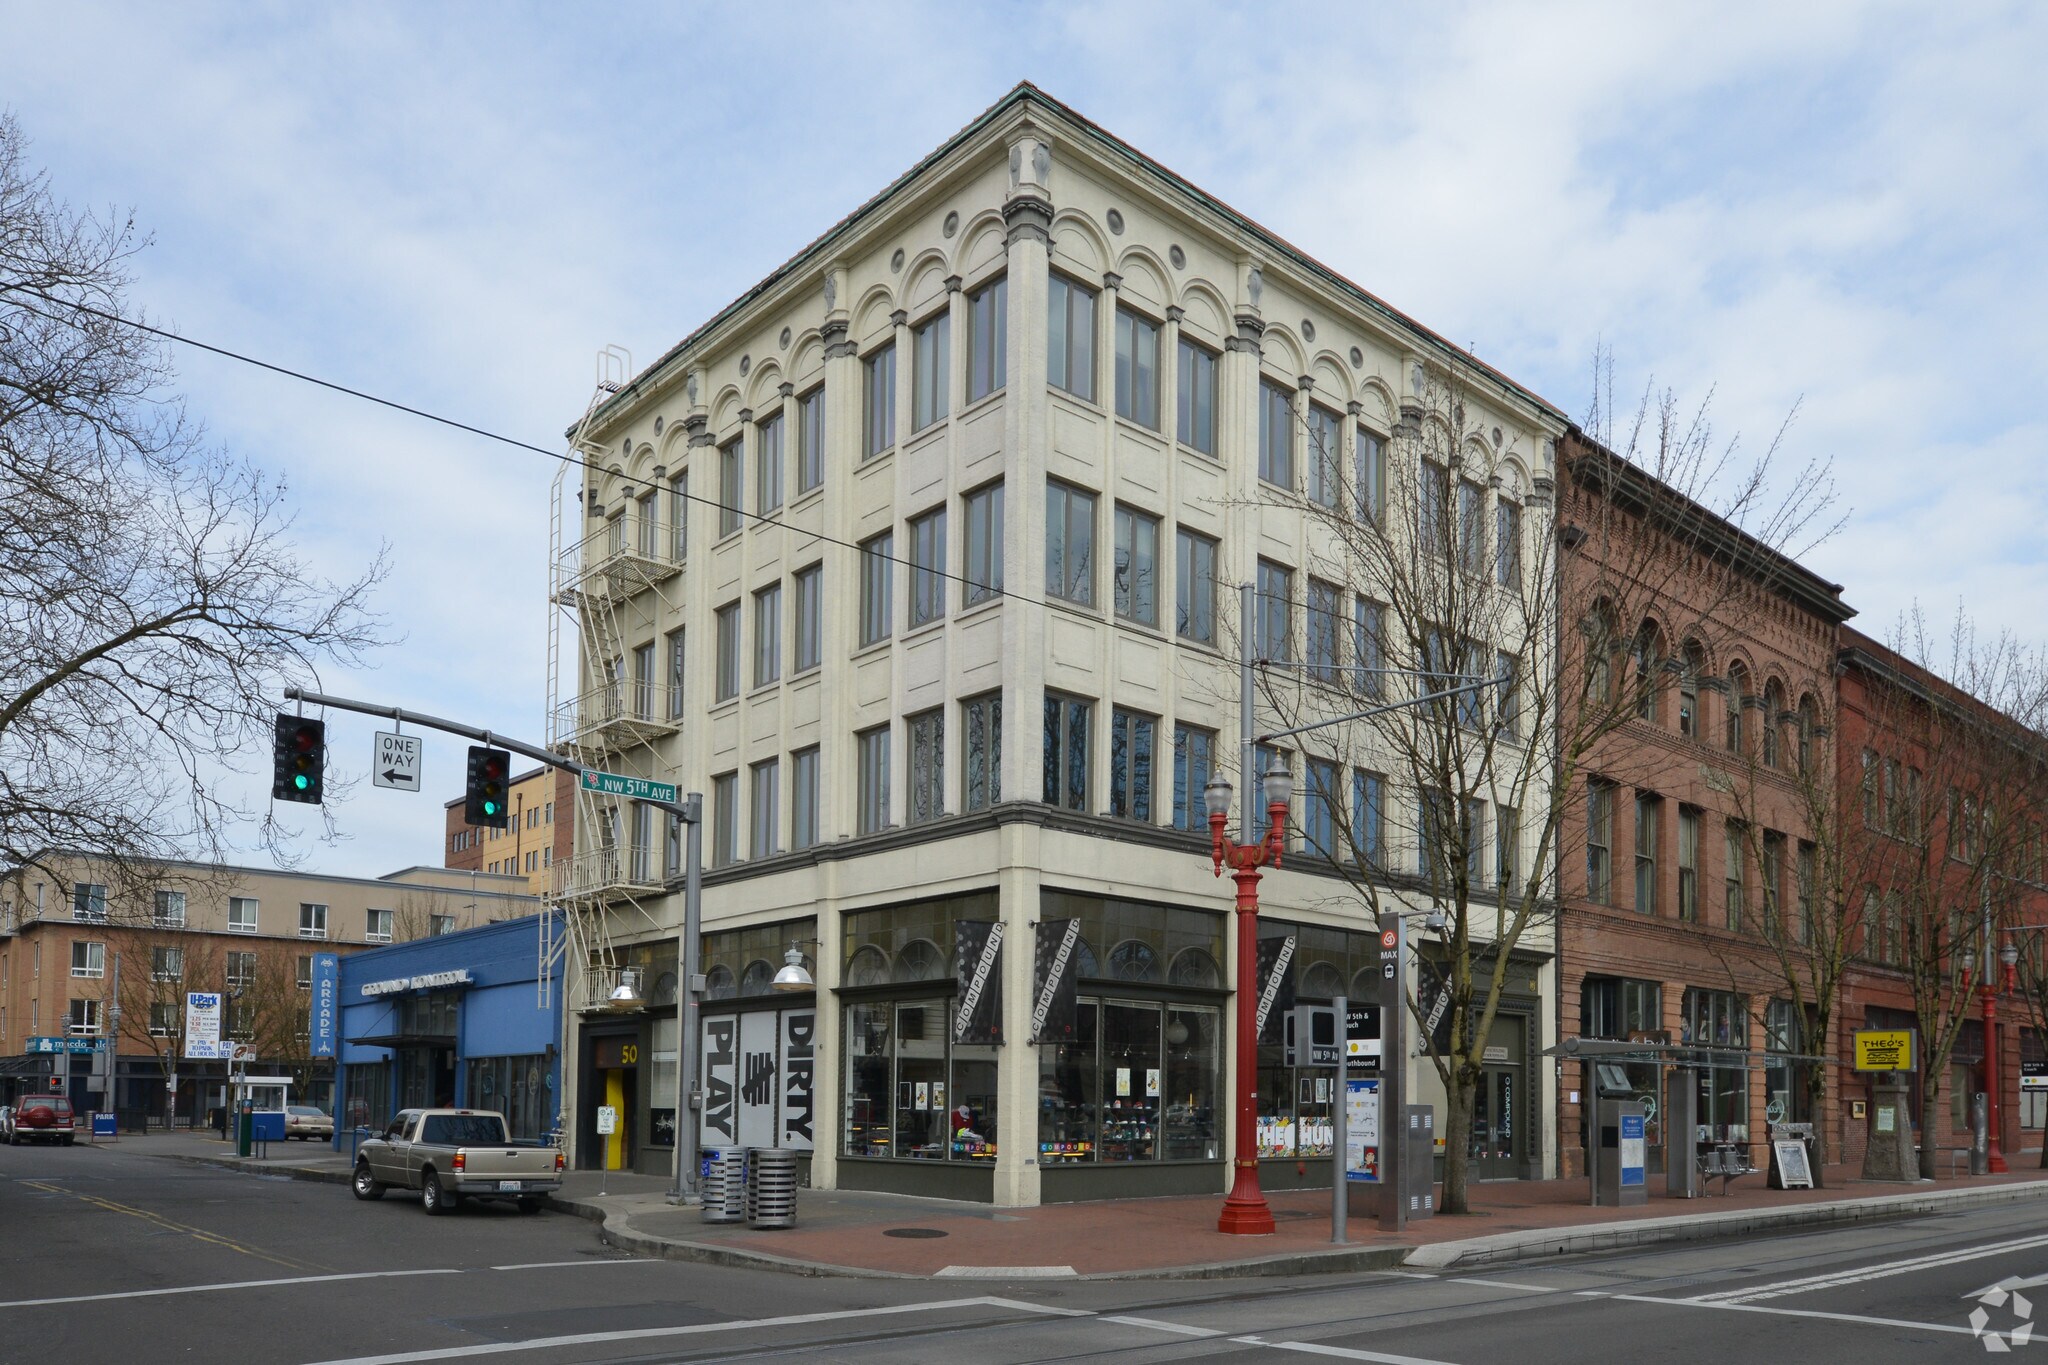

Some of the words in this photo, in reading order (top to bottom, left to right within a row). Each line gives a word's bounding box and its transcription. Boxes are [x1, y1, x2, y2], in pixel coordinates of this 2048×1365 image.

[383, 737, 414, 754] ONE
[382, 751, 415, 767] WAY
[604, 779, 623, 793] NW
[626, 780, 648, 794] 5TH
[651, 787, 672, 800] AVE
[1381, 951, 1397, 959] MAX
[957, 924, 1002, 1031] COMPOUND
[1032, 920, 1079, 1031] COMPOUND
[1257, 937, 1295, 1026] OMPOUND
[361, 978, 410, 996] GROUND
[190, 994, 217, 1006] U-Park
[320, 979, 331, 1038] ARCADE
[1862, 1040, 1905, 1048] THEO'S
[621, 1045, 638, 1064] 50
[1313, 1050, 1322, 1060] NW
[706, 1020, 733, 1139] PLAY
